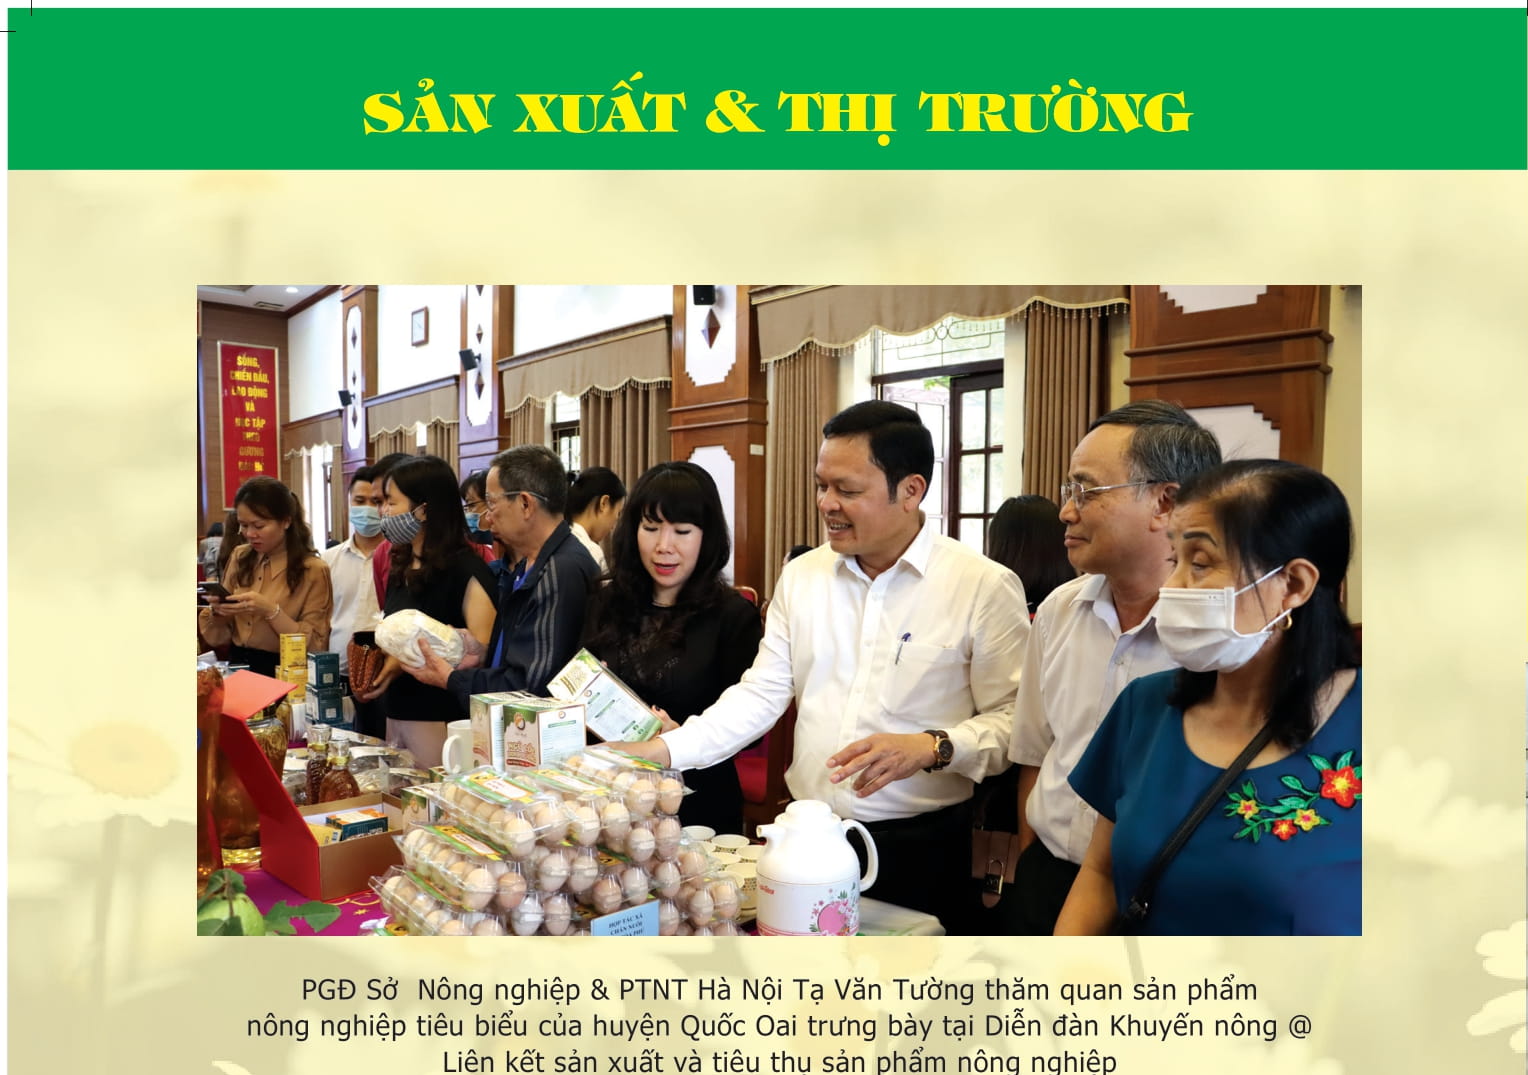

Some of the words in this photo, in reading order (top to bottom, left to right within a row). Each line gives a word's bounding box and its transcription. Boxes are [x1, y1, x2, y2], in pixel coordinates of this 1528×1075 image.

[363, 77, 496, 135] SẢN
[514, 71, 687, 134] XUẤT
[705, 89, 765, 134] &
[777, 91, 896, 147] THỊ
[918, 78, 1192, 133] TRƯỜNG
